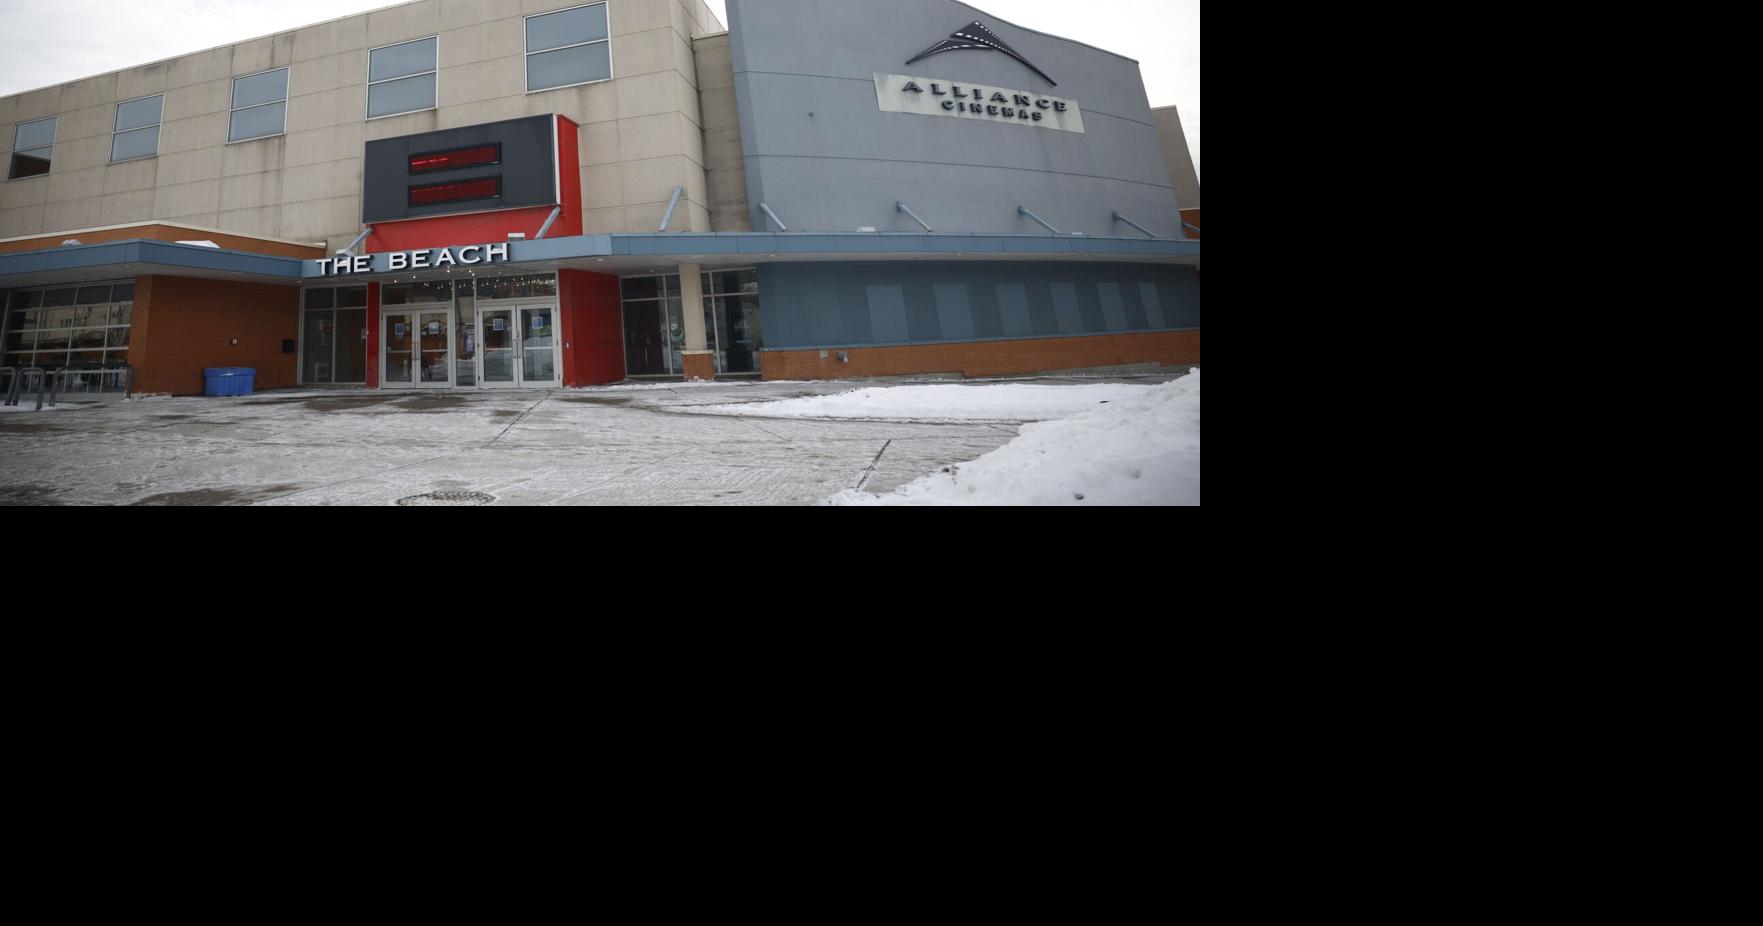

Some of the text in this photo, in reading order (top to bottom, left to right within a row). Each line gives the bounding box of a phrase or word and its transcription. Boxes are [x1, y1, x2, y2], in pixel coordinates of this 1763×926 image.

[902, 81, 1067, 112] ALLIANCE
[941, 100, 1042, 121] CINEMAS
[316, 242, 511, 276] THE BEACH
